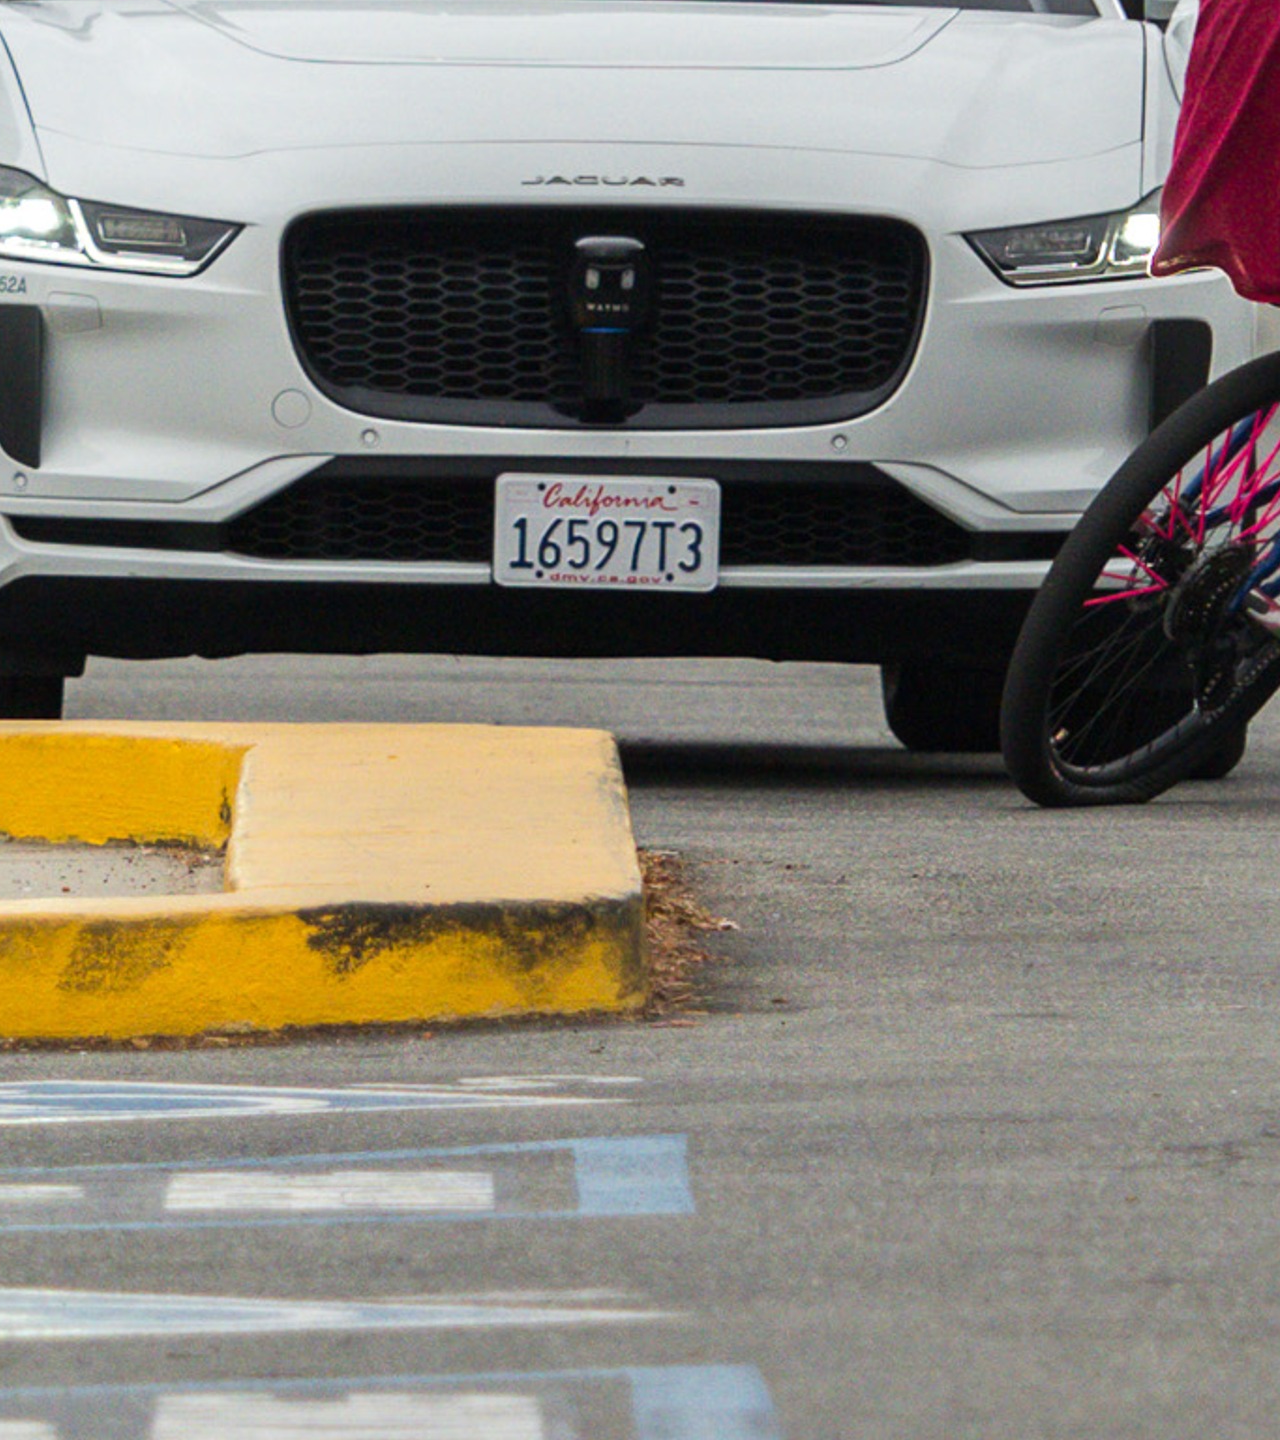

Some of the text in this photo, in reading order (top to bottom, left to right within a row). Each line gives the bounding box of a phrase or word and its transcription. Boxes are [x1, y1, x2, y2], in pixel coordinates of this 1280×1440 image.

[521, 175, 685, 187] JAGUAR
[586, 303, 630, 312] WAYMO
[542, 482, 679, 517] California
[509, 516, 704, 573] 16597T3
[549, 572, 662, 585] dmv.ca.gov
